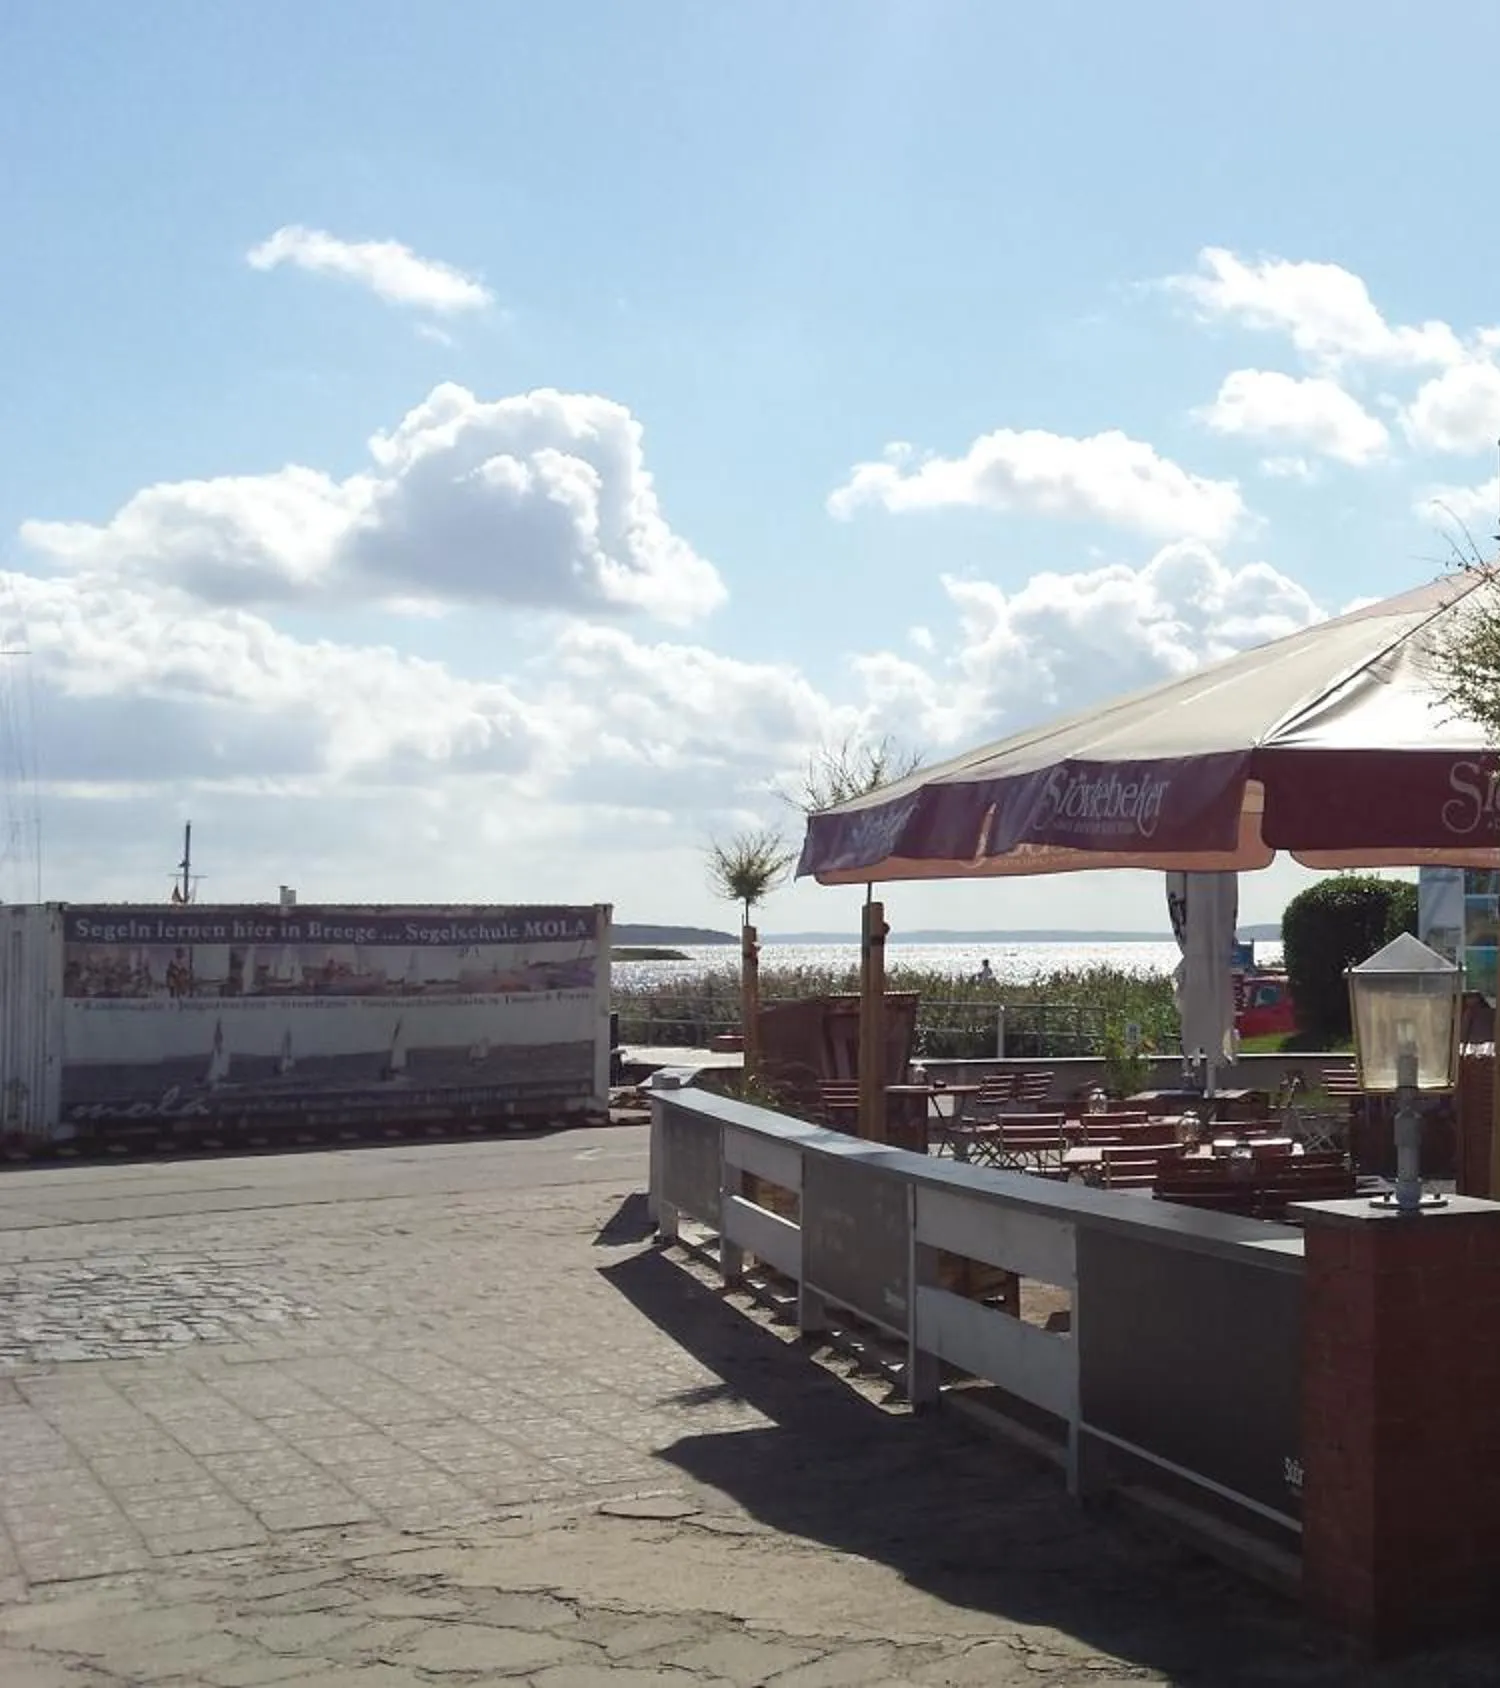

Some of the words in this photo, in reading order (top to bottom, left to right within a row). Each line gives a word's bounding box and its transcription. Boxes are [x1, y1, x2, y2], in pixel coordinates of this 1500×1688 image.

[75, 917, 150, 941] Segeln
[157, 919, 225, 938] lernen
[232, 919, 272, 938] hier
[280, 919, 300, 938] in
[307, 920, 375, 942] Breege
[405, 921, 519, 944] Segelschule
[523, 918, 592, 939] MOLA
